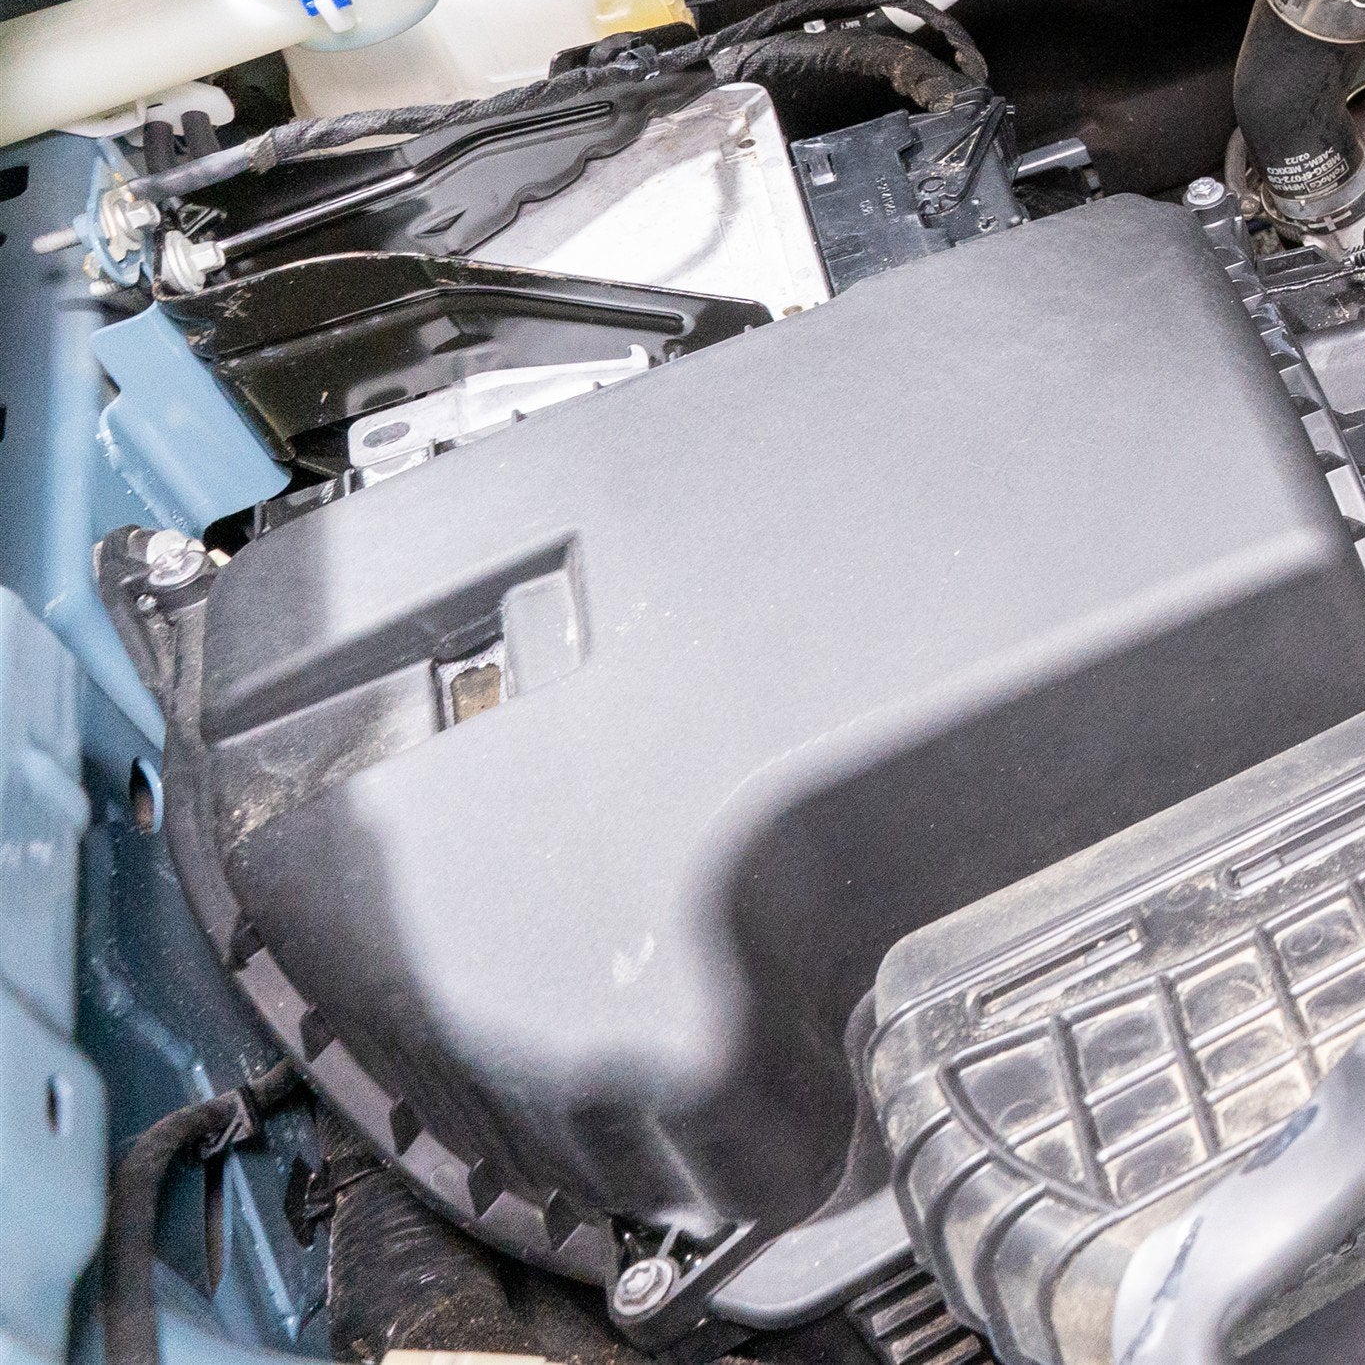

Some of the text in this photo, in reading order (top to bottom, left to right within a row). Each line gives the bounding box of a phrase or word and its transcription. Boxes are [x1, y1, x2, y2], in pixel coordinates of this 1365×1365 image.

[1283, 152, 1309, 164] 02/22
[1266, 164, 1302, 173] MEXICO
[1309, 164, 1345, 188] FoMoCo
